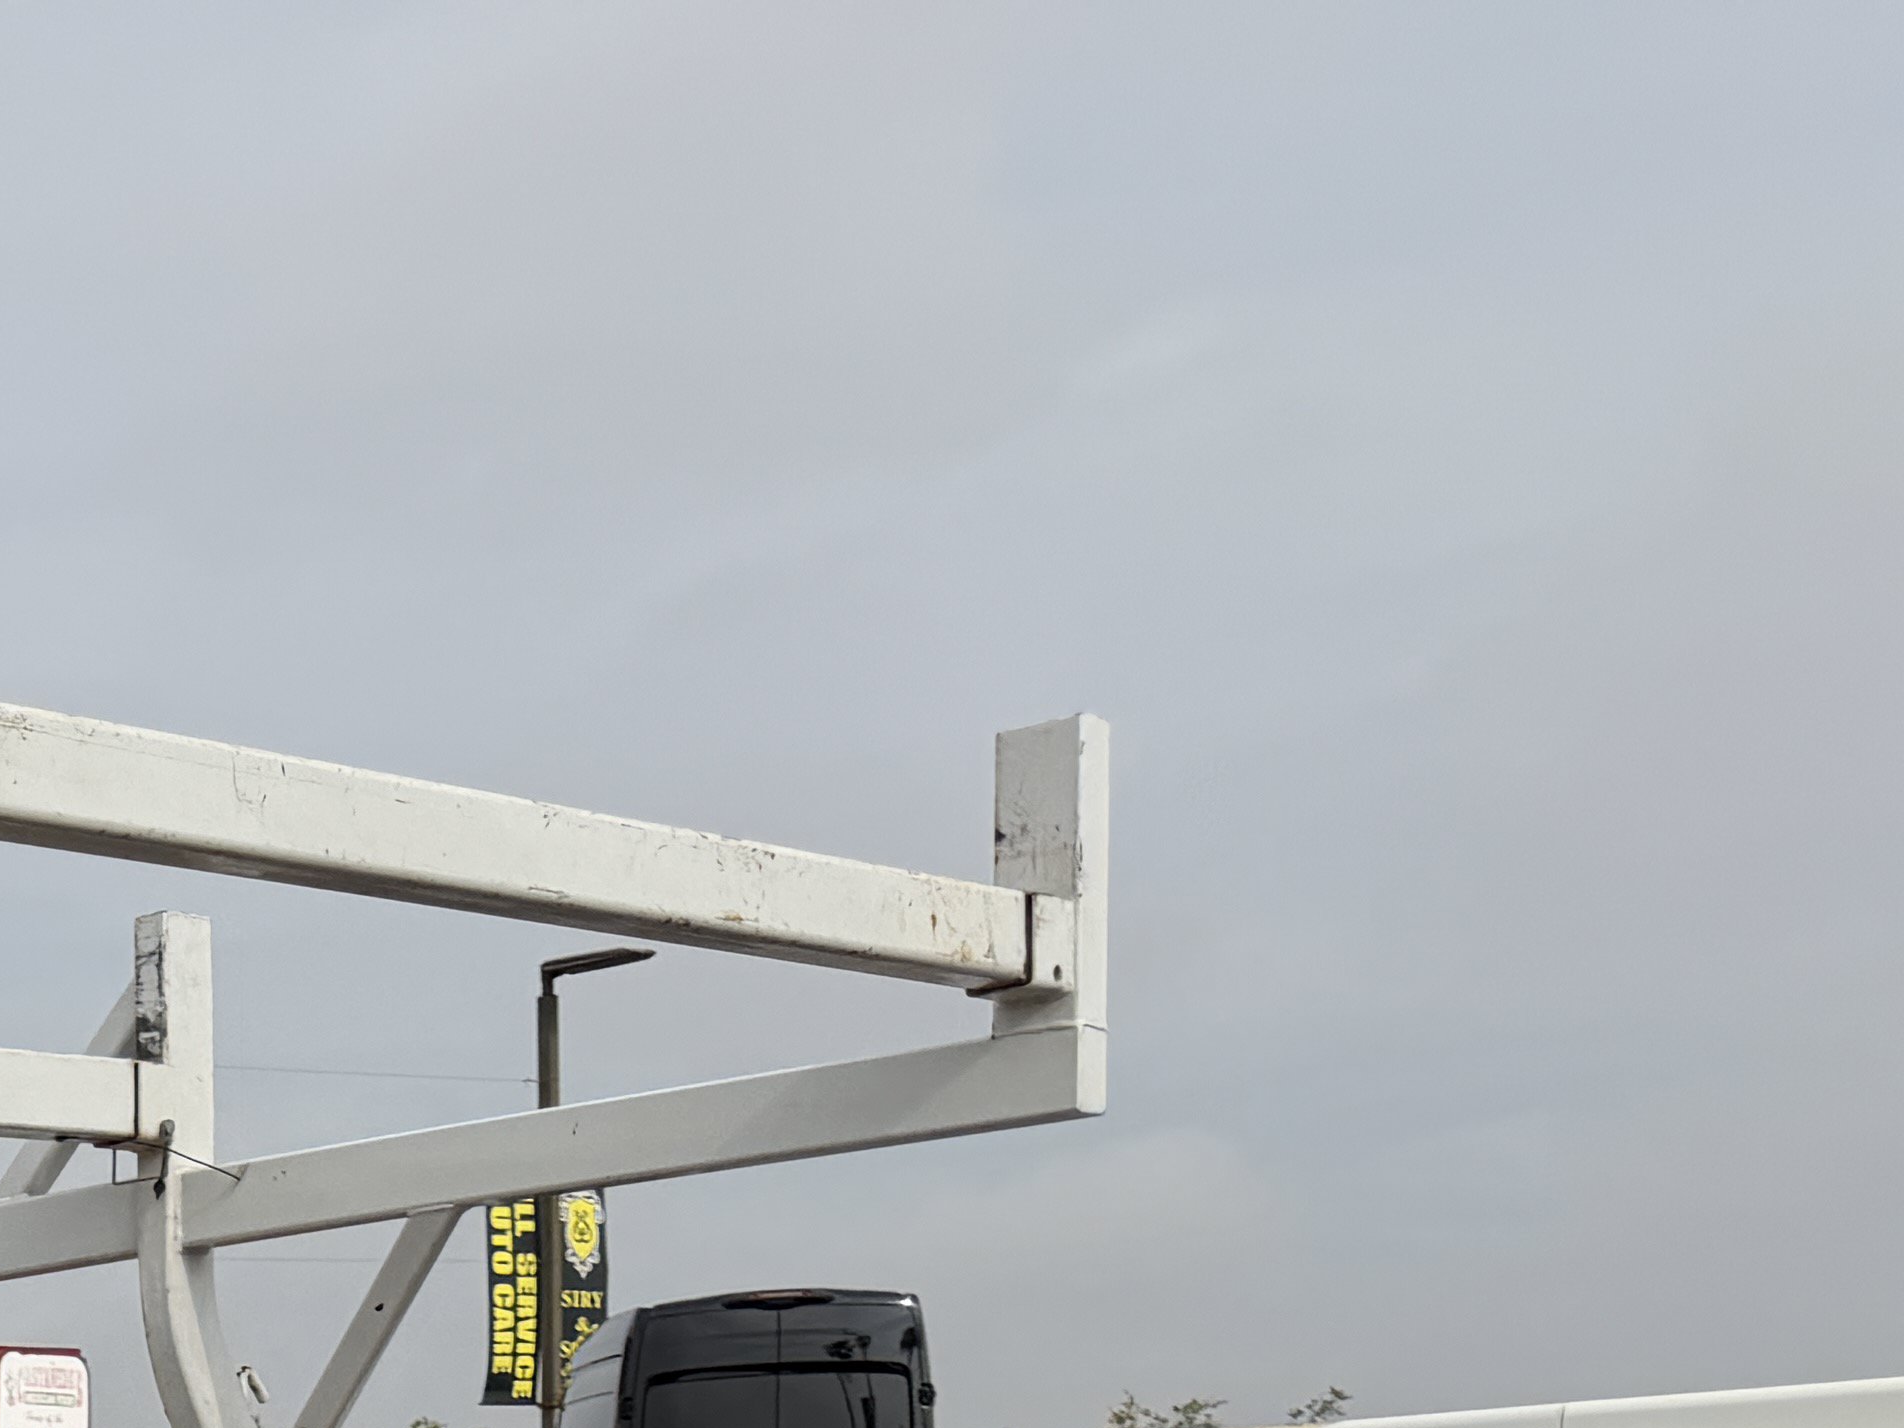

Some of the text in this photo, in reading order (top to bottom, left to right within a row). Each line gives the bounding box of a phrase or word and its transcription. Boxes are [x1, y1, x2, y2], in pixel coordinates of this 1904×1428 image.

[490, 1206, 515, 1374] UTO CARE
[512, 1252, 538, 1398] SERVICE
[560, 1289, 604, 1310] SIRY
